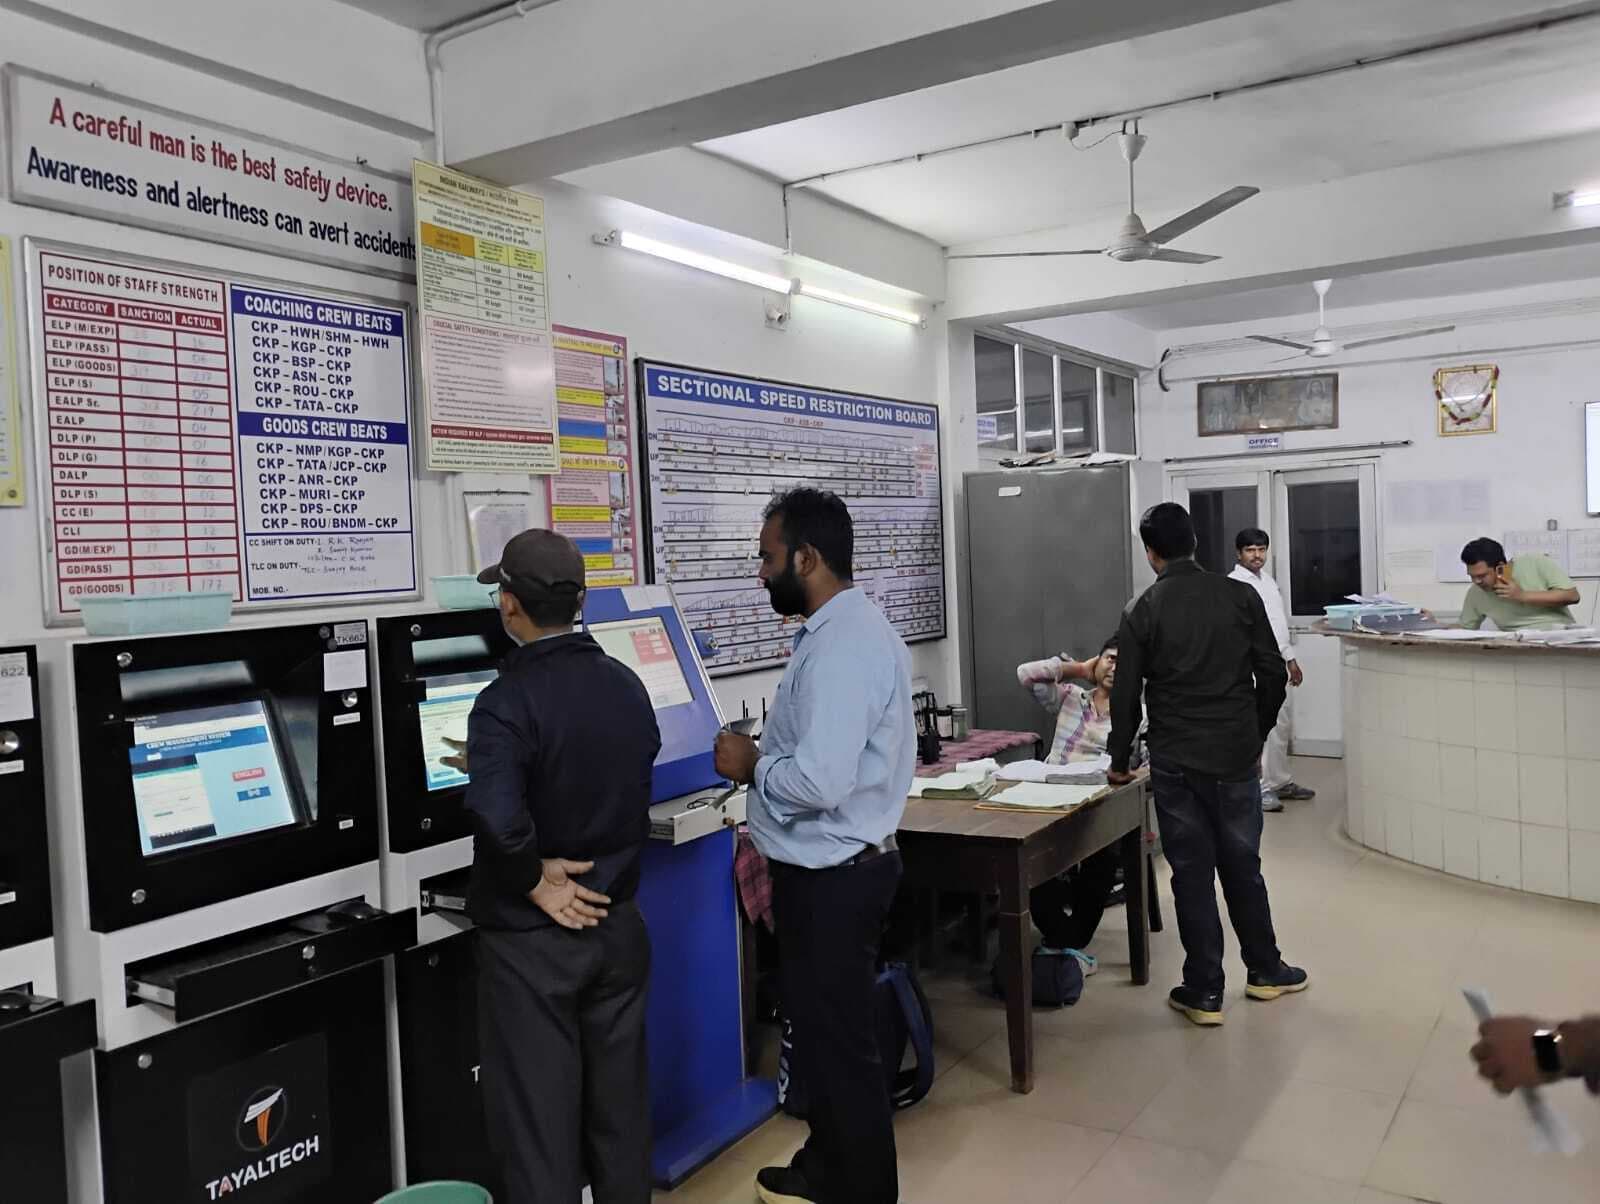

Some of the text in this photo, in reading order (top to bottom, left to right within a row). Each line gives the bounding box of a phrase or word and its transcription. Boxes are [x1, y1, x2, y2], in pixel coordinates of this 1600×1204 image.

[49, 98, 393, 212] A careful man is the best safety device.
[27, 147, 138, 198] Awareness
[146, 178, 179, 207] and
[186, 187, 269, 227] alertness
[275, 212, 302, 235] can
[309, 218, 349, 246] avert
[48, 265, 218, 302] POSITION OF STAFF STRENGTH
[53, 297, 217, 329] CATEGORY SANCTION ACTUAL
[245, 295, 392, 331] COACHING CREW BEATS
[51, 320, 71, 330] ELP
[251, 321, 389, 349] CKP HWH/SHM HWH
[52, 339, 110, 353] ELP (PASS)
[252, 336, 351, 357] CKP KGP CKP
[52, 358, 116, 372] ELP (GOODS)
[253, 351, 351, 372] CKP BSP CKP
[54, 377, 93, 388] ELP (S)
[253, 366, 352, 386] CKP ASN CKP
[255, 381, 353, 400] CKP ROU CKP
[55, 396, 83, 406] EALP
[256, 396, 358, 414] CKP TATA CKP
[658, 375, 931, 425] SECTIONAL SPEED RESTRICTION BOARD
[56, 415, 85, 425] EALP
[263, 417, 387, 440] GOODS CREW BEATS
[57, 434, 96, 444] DLP (P)
[58, 452, 97, 463] DLP (G)
[256, 442, 384, 459] CKP NMP/KGP CKP
[257, 458, 386, 473] CKP TATA/JCP CKP
[59, 471, 88, 480] DALP
[259, 473, 357, 486] CKP ANR CKP
[61, 490, 97, 499] DLP (S)
[260, 489, 365, 500] CKP MURI CKP
[62, 508, 93, 517] CC (E)
[261, 504, 357, 514] CKP DPS CKP
[262, 518, 398, 529] CKP ROU/BNDM CKP
[62, 527, 80, 536] CLI
[66, 564, 112, 574] GD(PASS)
[267, 562, 278, 570] ON
[68, 583, 124, 594] GD(GOODS)
[205, 1135, 319, 1200] TAYALTECH
